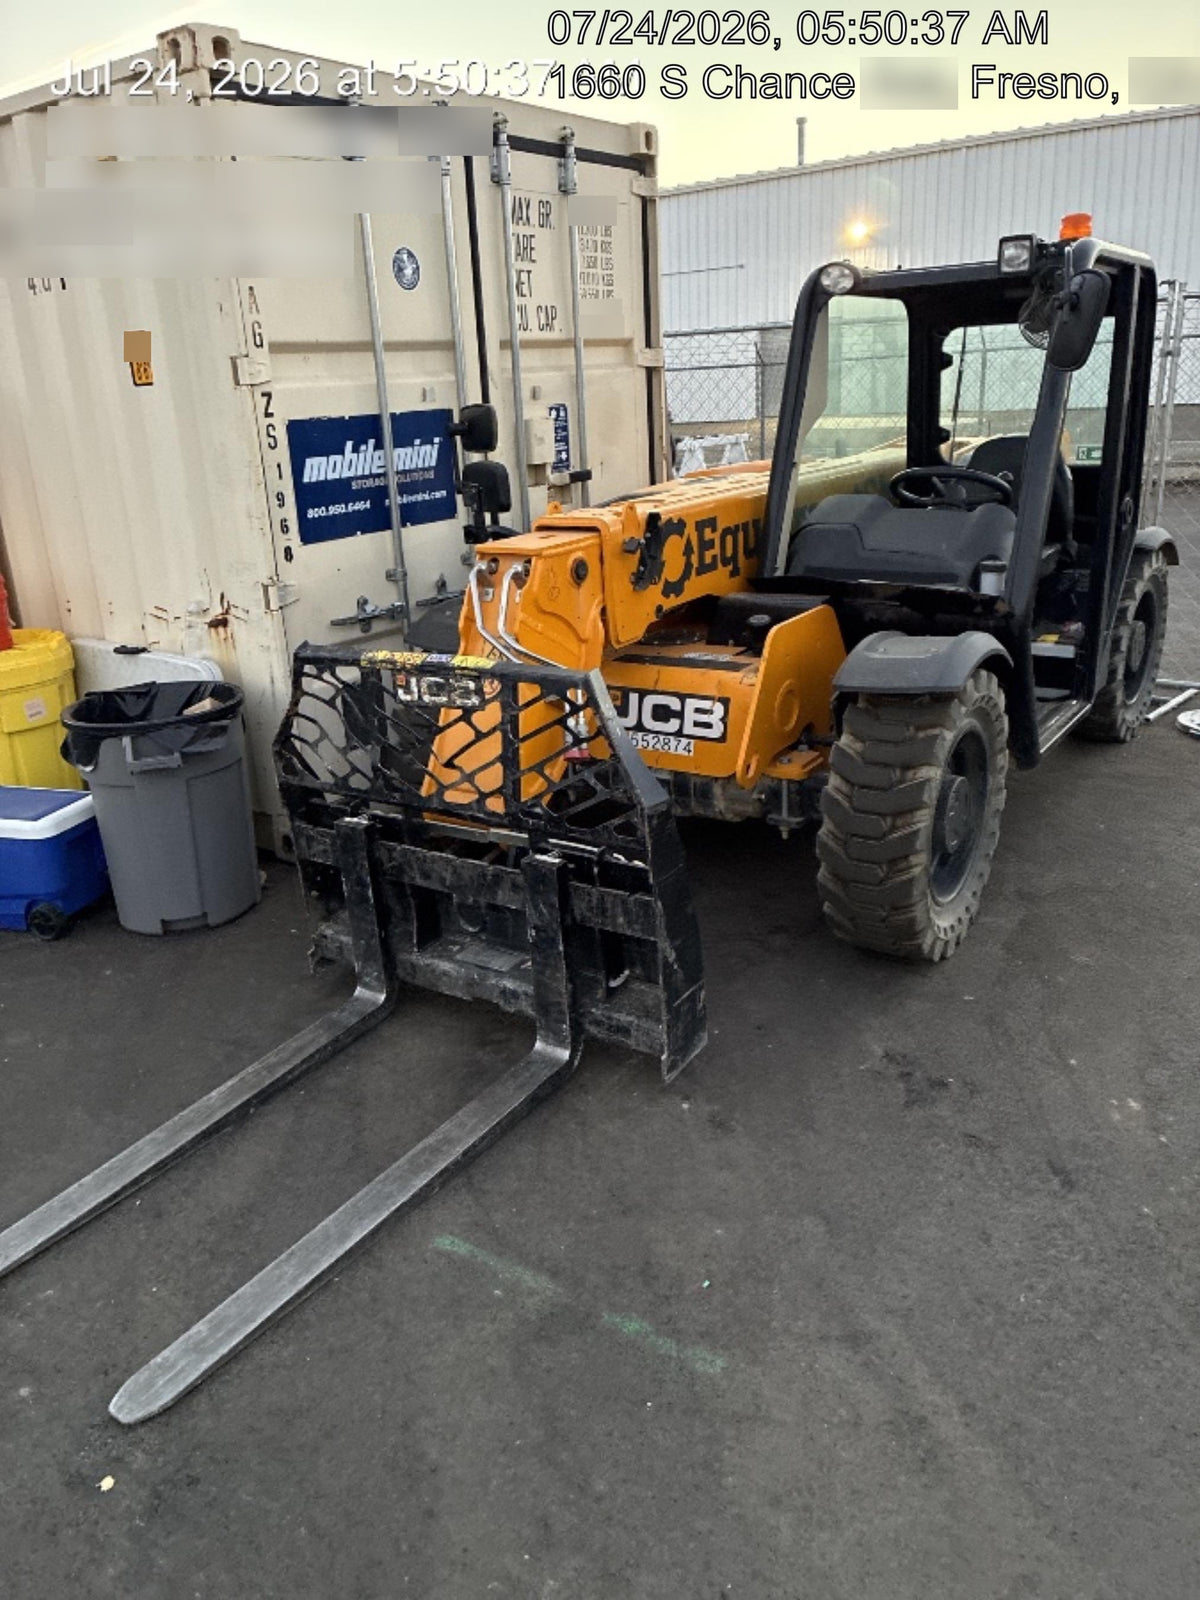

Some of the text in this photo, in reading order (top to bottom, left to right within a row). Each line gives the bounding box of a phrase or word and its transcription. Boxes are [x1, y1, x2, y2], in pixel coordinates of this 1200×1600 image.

[512, 233, 537, 263] ARE
[302, 438, 387, 484] mobile
[351, 469, 435, 490] STORAG OLUTIONS
[385, 489, 447, 506] mbilemini.com
[615, 691, 725, 739] JCB
